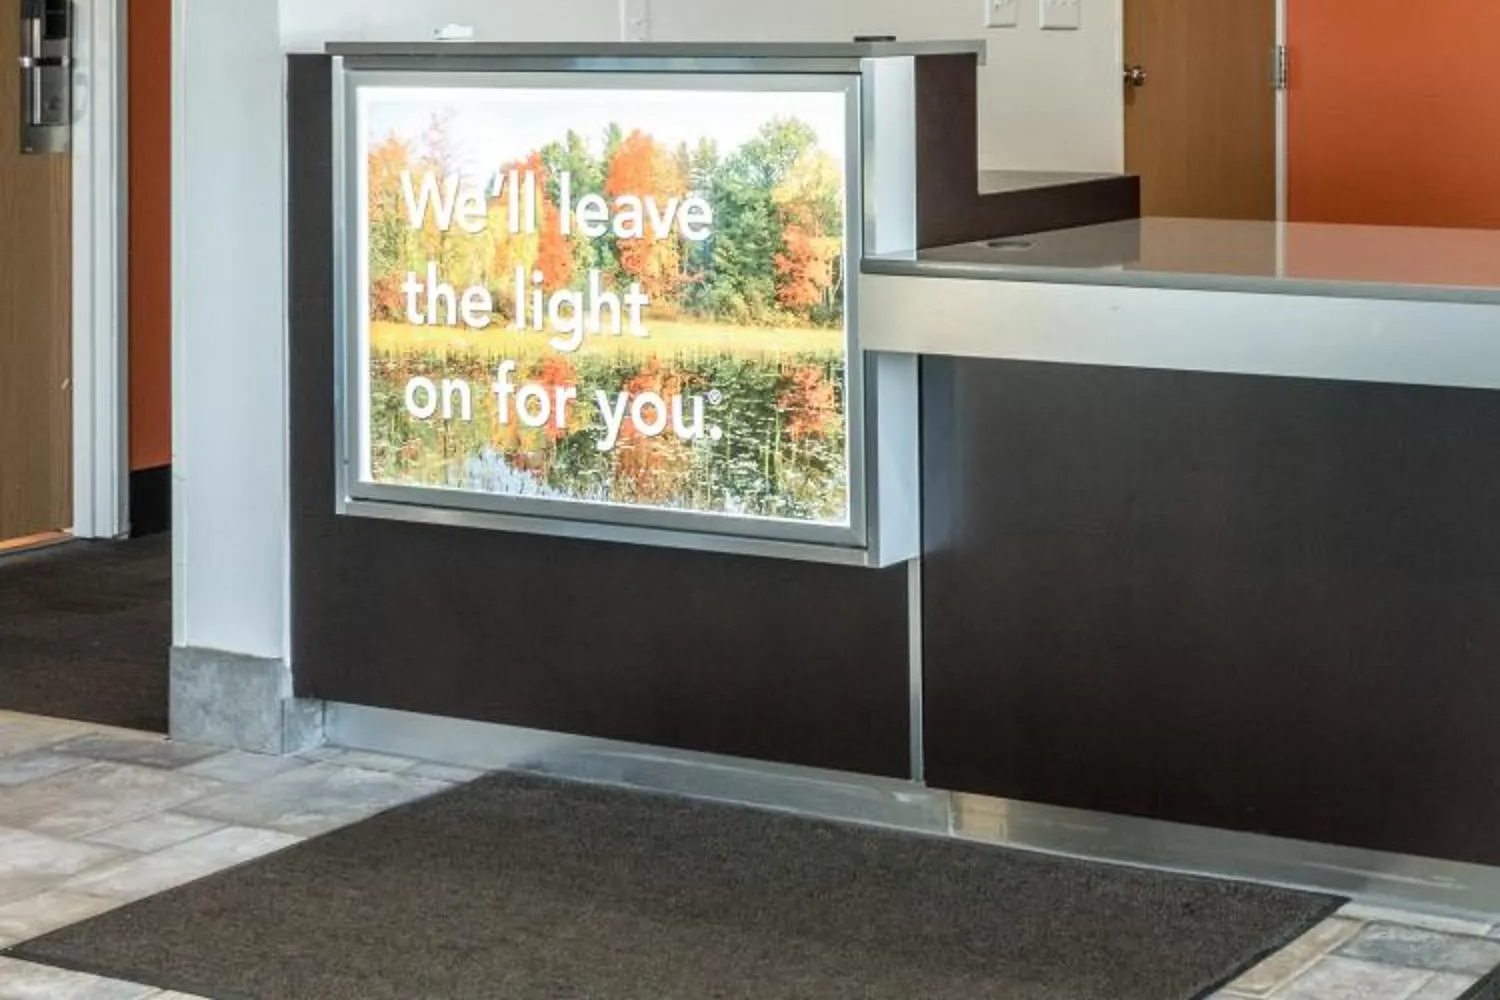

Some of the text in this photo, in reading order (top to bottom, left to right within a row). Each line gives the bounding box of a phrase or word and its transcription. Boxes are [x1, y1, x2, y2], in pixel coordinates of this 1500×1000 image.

[400, 170, 714, 240] We'll leave
[402, 261, 651, 352] the light
[404, 375, 472, 421] on
[491, 360, 578, 430] for
